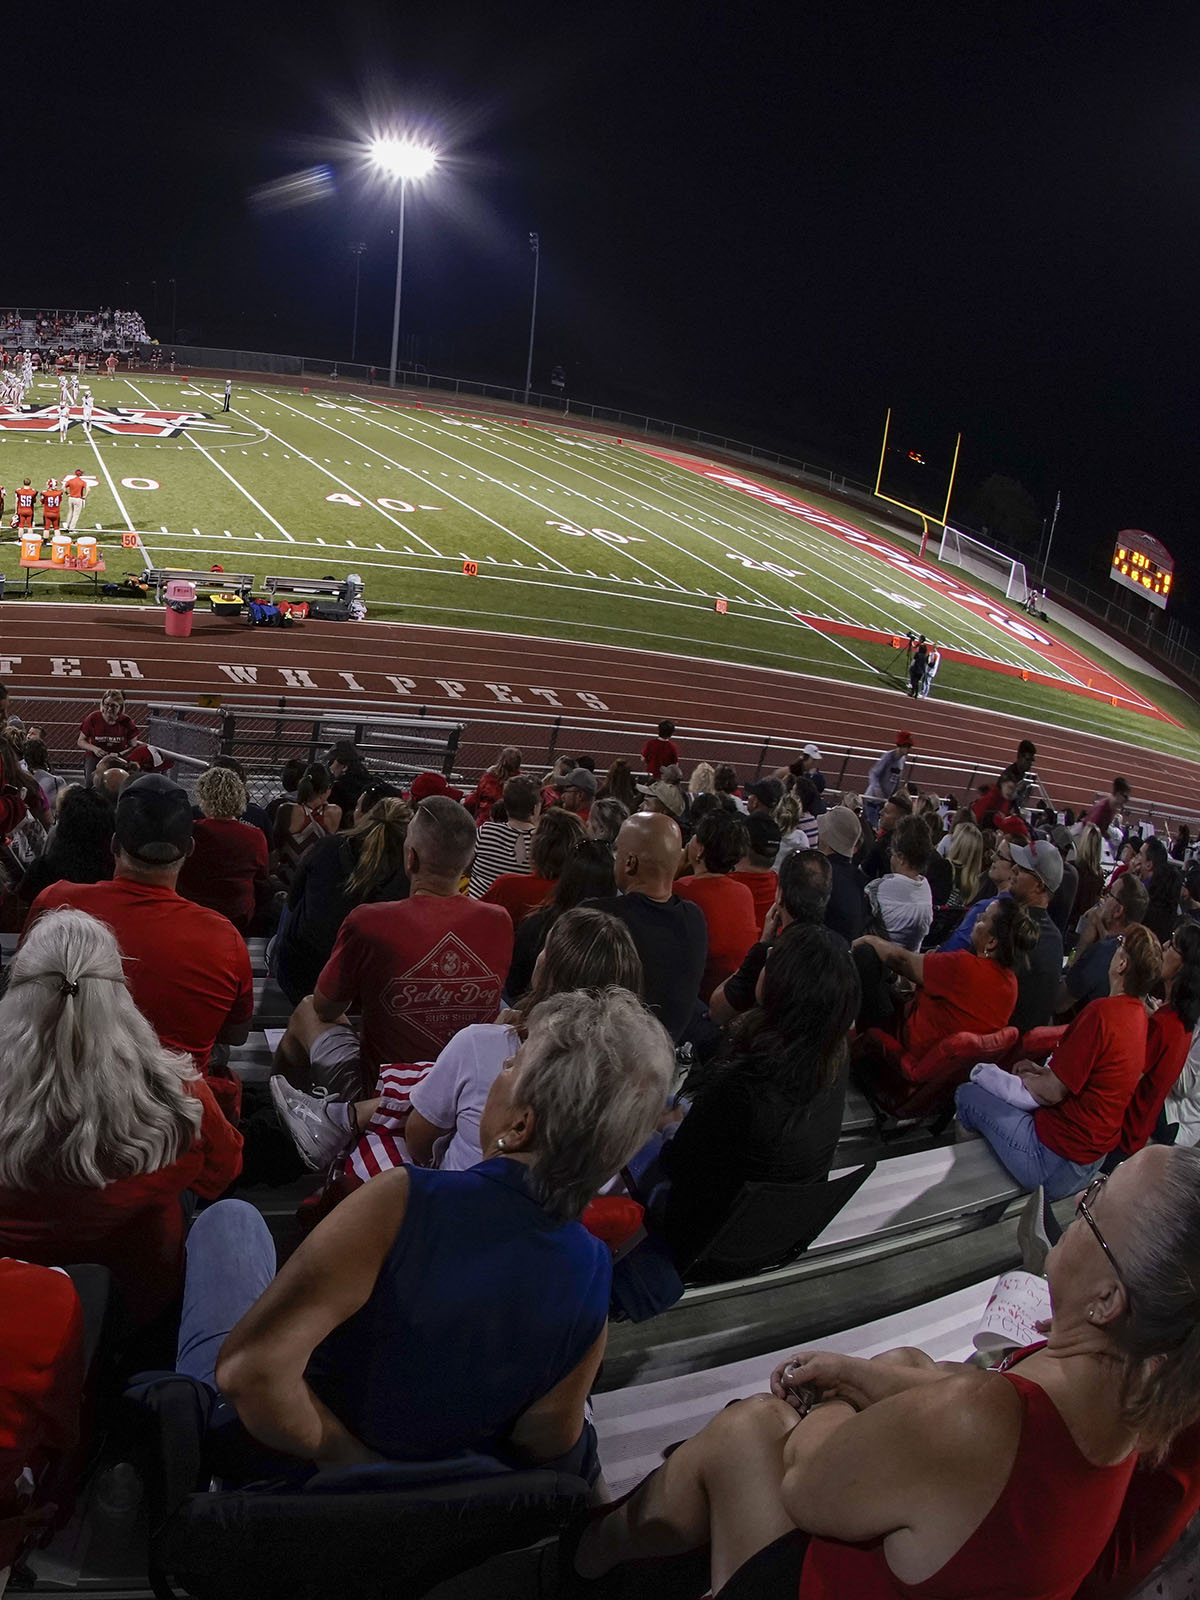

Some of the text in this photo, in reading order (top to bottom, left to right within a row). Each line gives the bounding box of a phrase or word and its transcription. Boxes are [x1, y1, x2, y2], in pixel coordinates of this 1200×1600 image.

[324, 492, 417, 512] 40
[124, 535, 137, 546] 50
[545, 520, 630, 544] 30
[464, 562, 477, 574] 40
[218, 665, 609, 711] WHIPPETS
[391, 982, 498, 1008] Salty Dog
